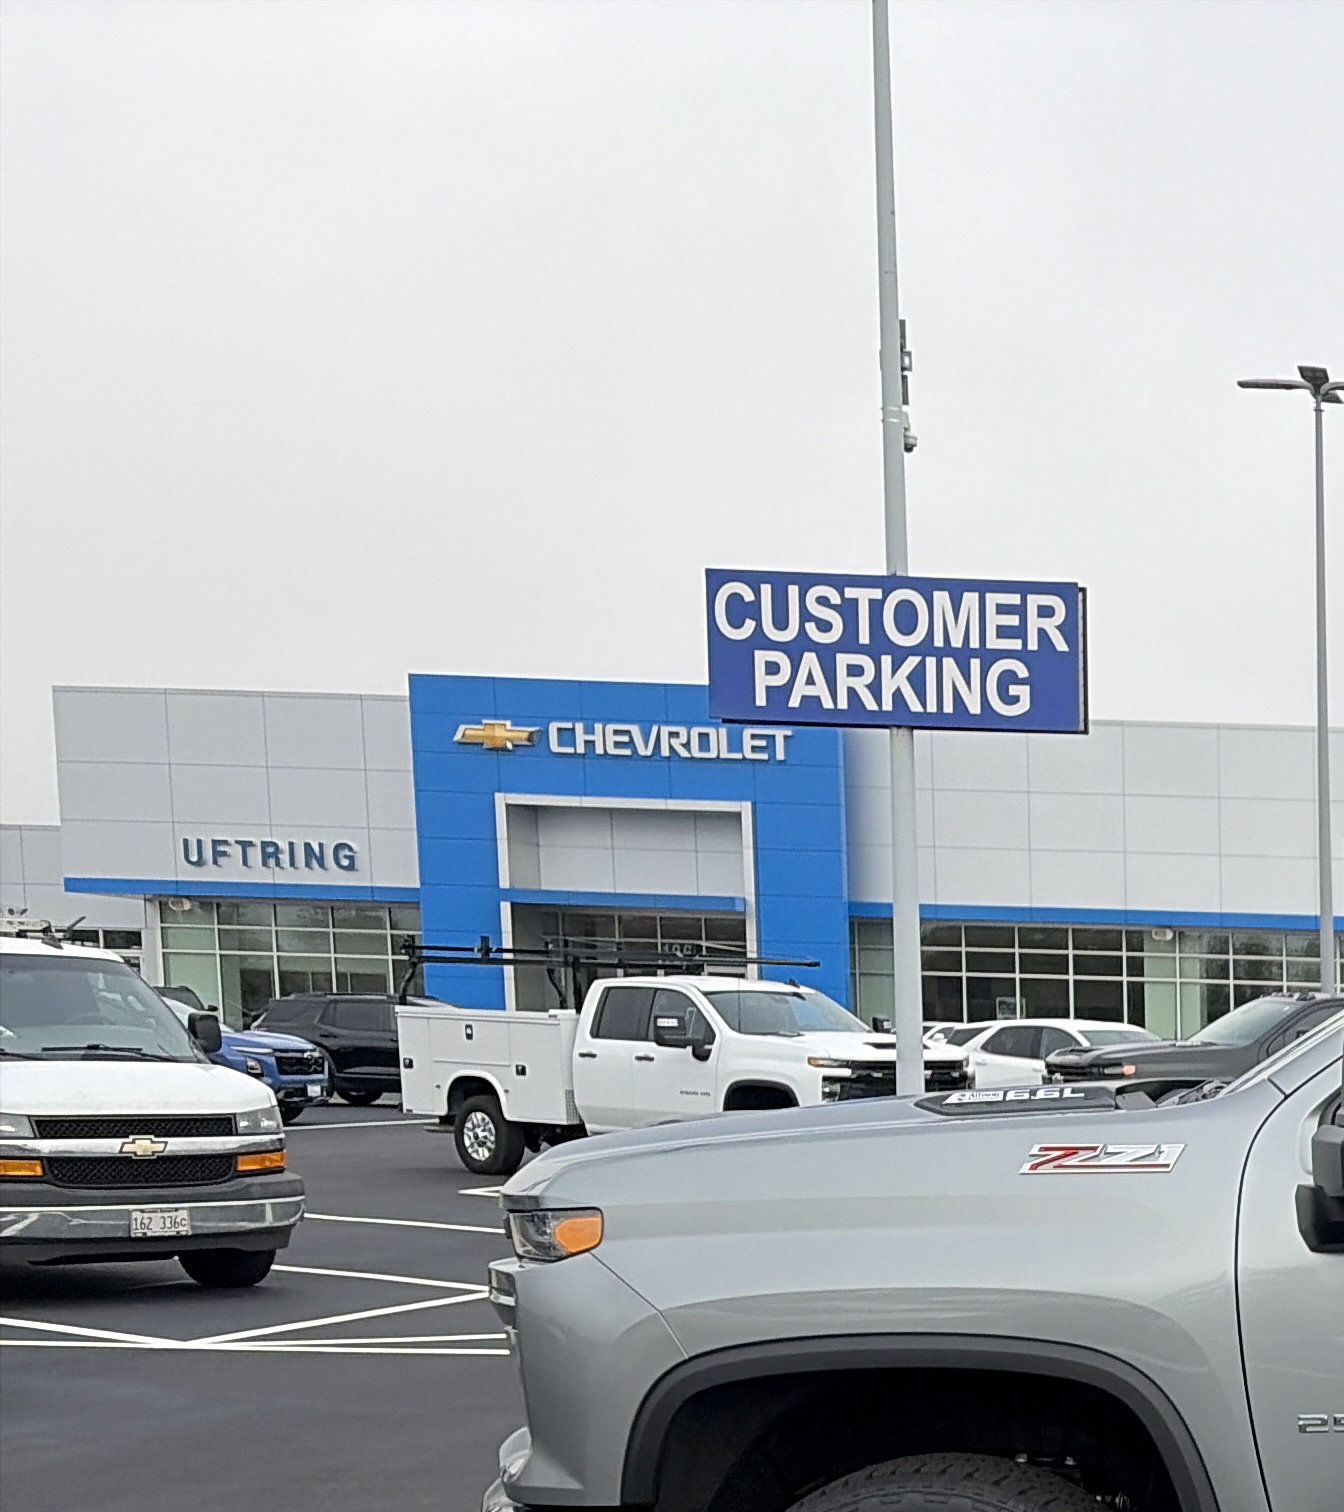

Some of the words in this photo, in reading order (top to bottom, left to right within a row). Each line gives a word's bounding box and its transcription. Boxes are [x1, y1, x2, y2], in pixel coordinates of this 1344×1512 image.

[714, 581, 1070, 653] CUSTOMER
[753, 649, 1031, 717] PARKING
[548, 721, 793, 762] CHEVROLET
[182, 837, 359, 872] UFTRING
[1006, 1087, 1085, 1101] 6.6L
[1019, 1143, 1188, 1175] Z71
[133, 1216, 153, 1231] 162
